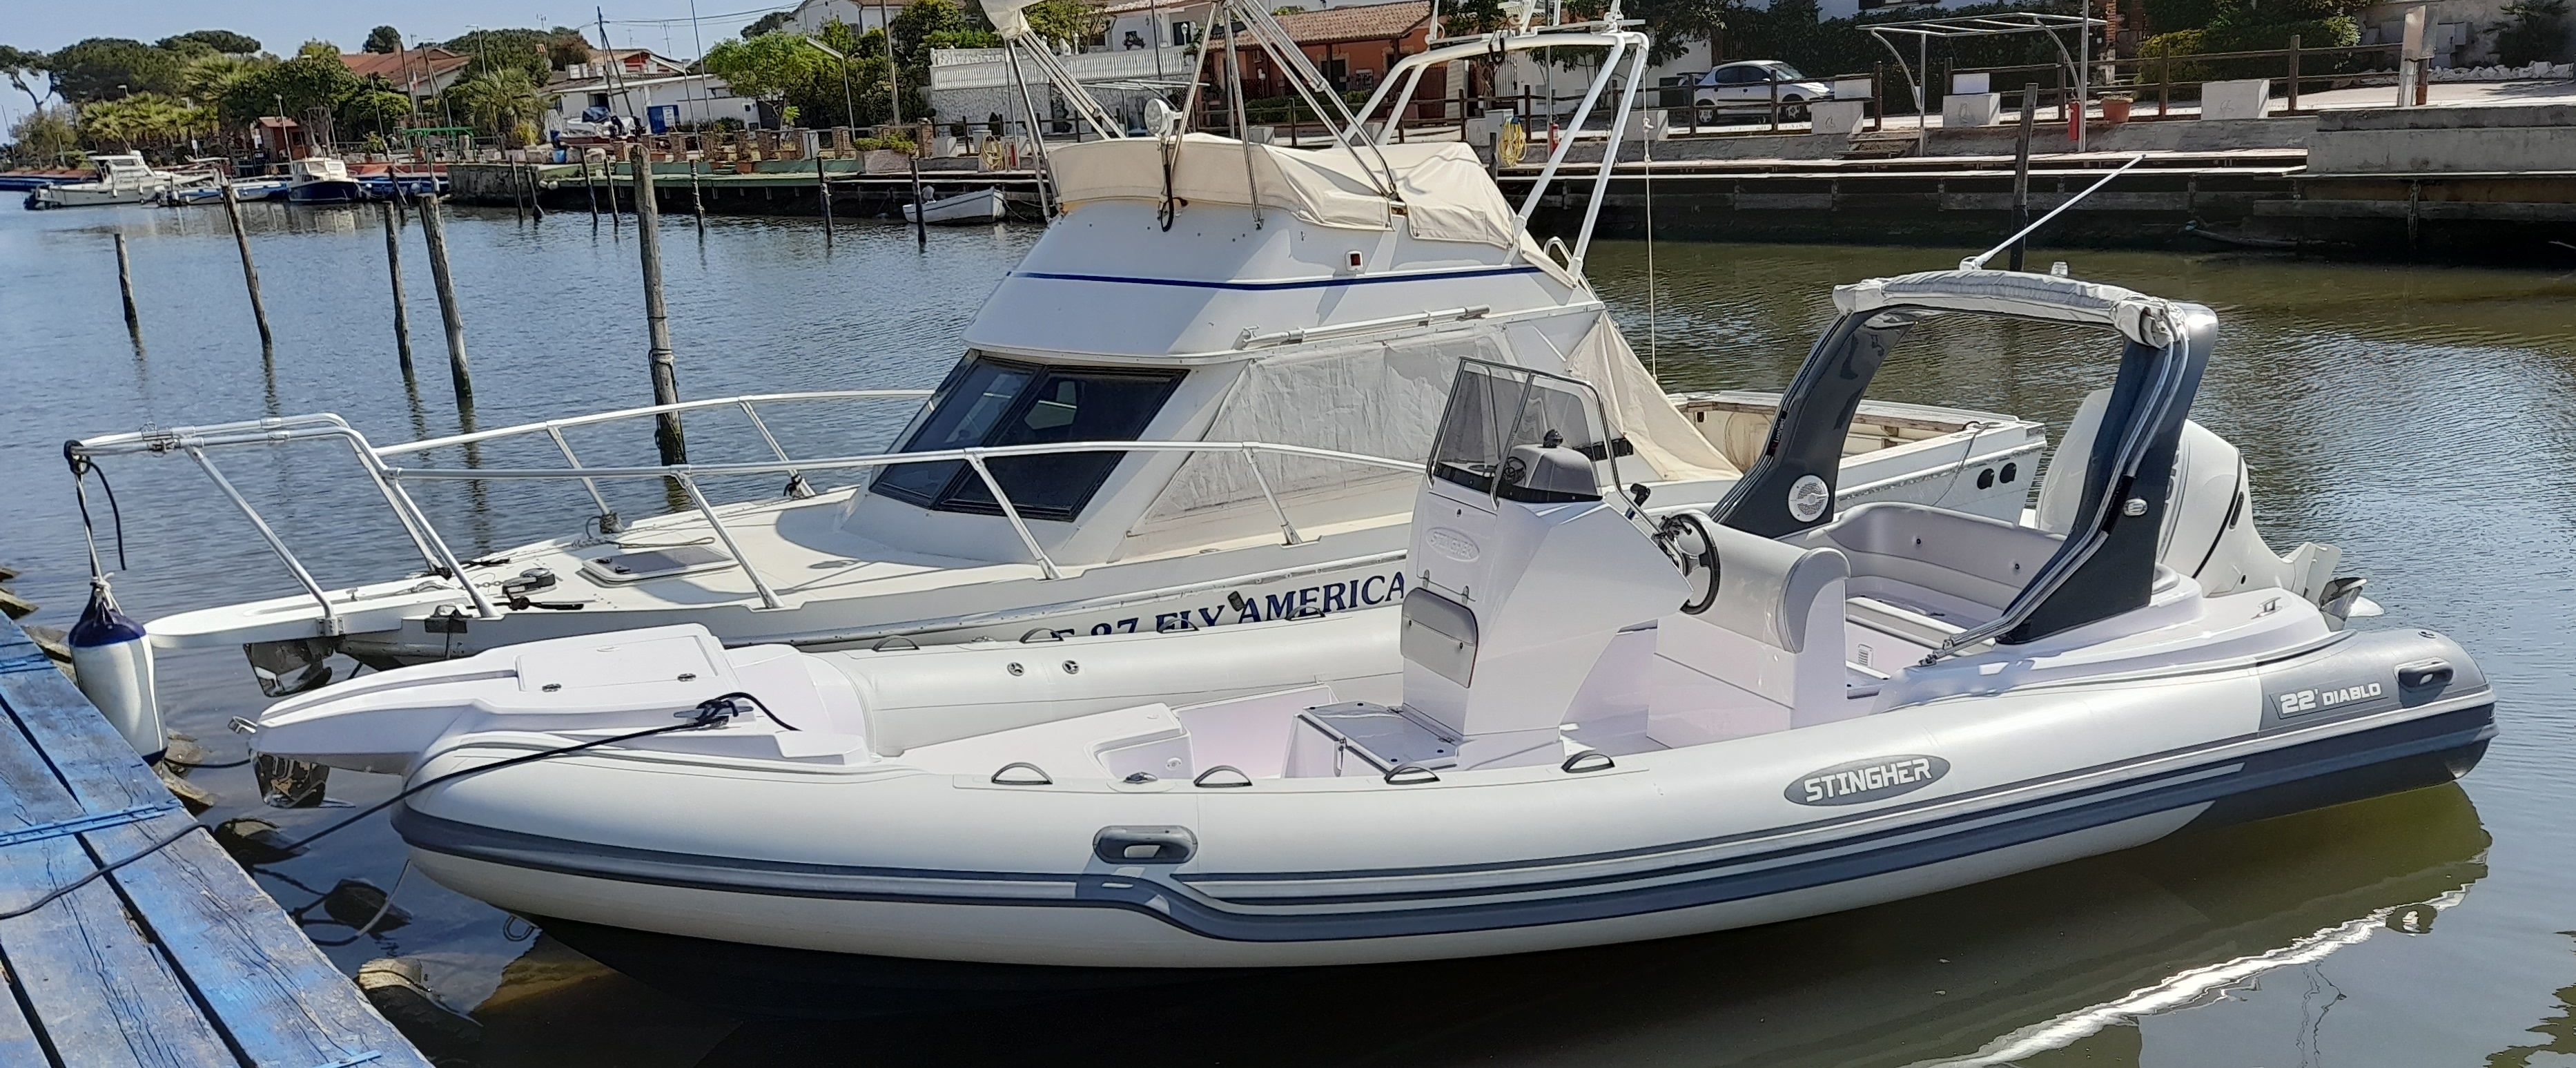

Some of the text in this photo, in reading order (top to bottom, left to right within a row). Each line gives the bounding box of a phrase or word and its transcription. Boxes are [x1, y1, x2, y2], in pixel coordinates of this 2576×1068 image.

[1238, 571, 1405, 624] AMERICA
[2280, 682, 2382, 715] 22' DIABLO
[1804, 758, 1933, 803] STINGHER
